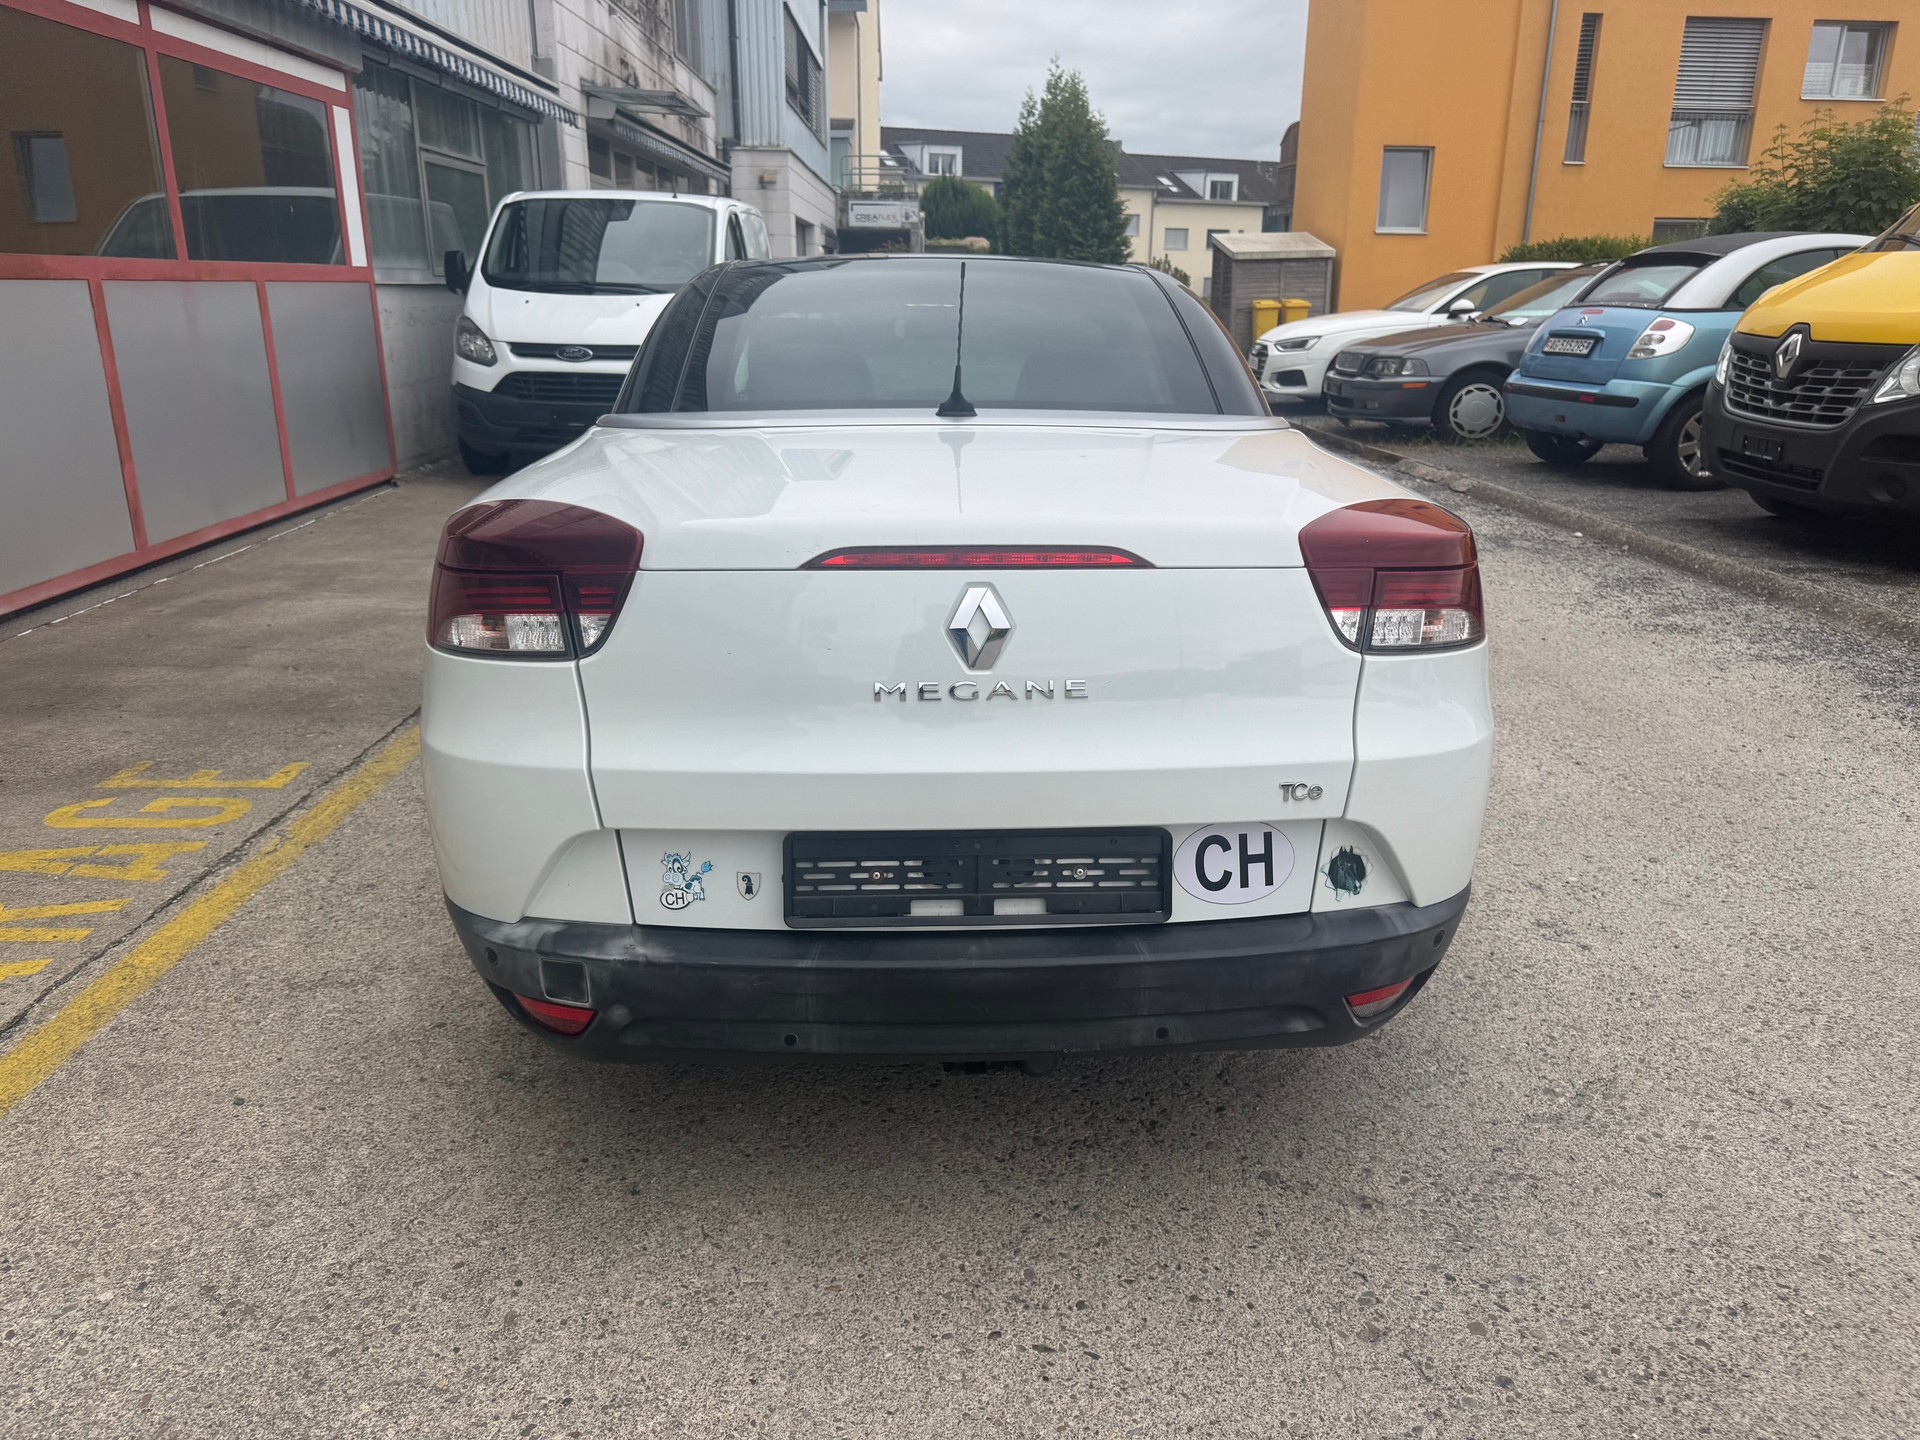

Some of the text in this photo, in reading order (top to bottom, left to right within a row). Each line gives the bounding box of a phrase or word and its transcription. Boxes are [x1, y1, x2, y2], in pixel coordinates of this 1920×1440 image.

[873, 679, 1089, 702] MEGANE
[1279, 781, 1323, 802] TCe
[1194, 830, 1275, 892] CH
[665, 892, 685, 906] CH
